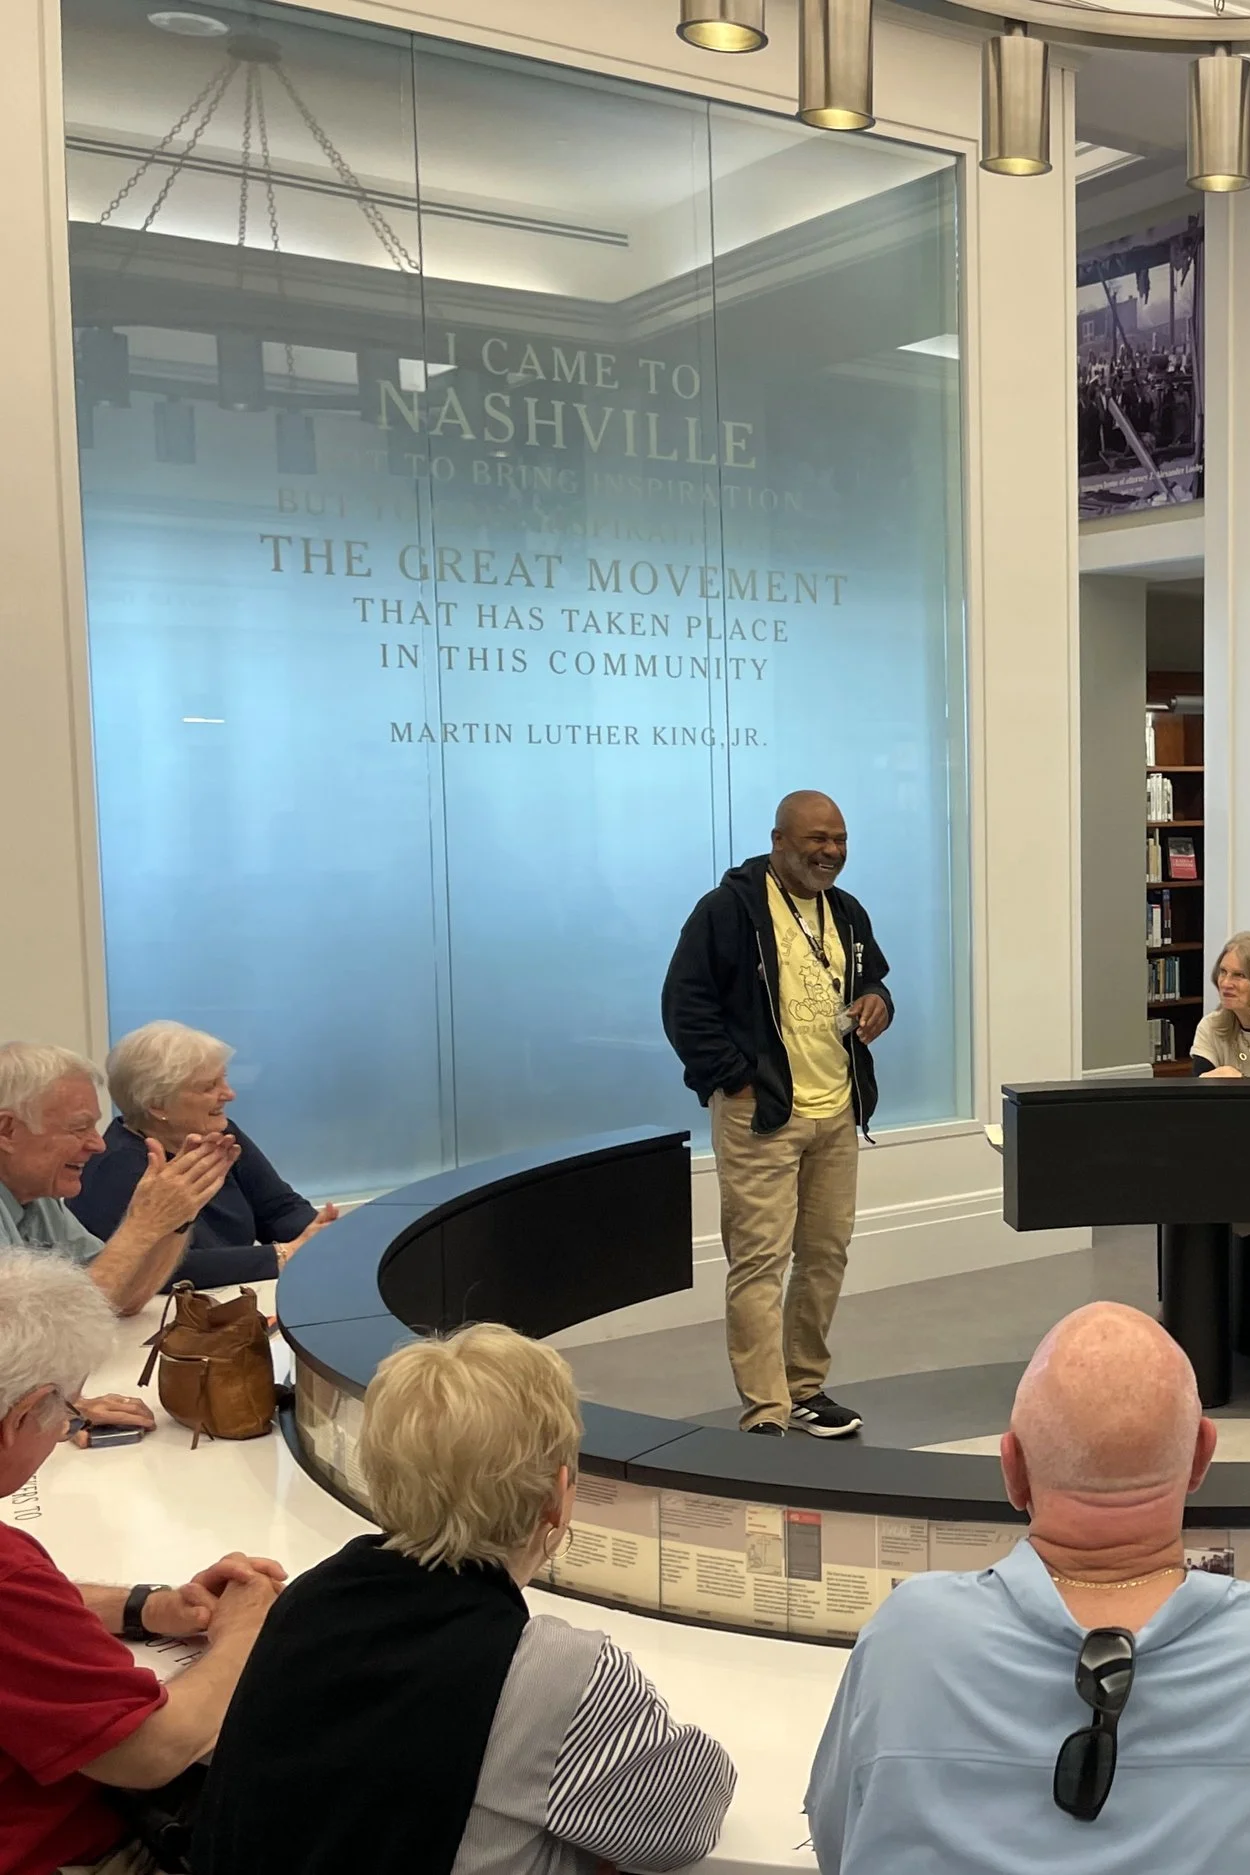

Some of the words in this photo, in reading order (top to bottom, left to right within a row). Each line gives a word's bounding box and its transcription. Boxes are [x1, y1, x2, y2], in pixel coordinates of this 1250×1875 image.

[445, 332, 457, 366] I
[481, 337, 620, 390] CAME
[638, 358, 702, 400] TO
[375, 379, 757, 469] NASHVILLE
[404, 452, 456, 482] TO
[472, 459, 578, 495] BRING
[591, 471, 803, 513] INSPIRATION
[259, 534, 372, 578] THE
[398, 544, 562, 589] GREAT
[587, 557, 848, 606] MOVEMENT
[353, 597, 458, 627] THAT
[477, 603, 545, 631] HAS
[561, 608, 670, 637] TAKEN
[686, 615, 789, 643] PLACE
[380, 643, 419, 669] IN
[439, 645, 528, 673] THIS
[549, 650, 769, 681] COMMUNITY
[390, 722, 512, 744] MARTIN
[527, 723, 641, 746] LUTHER
[13, 1505, 42, 1521] TO
